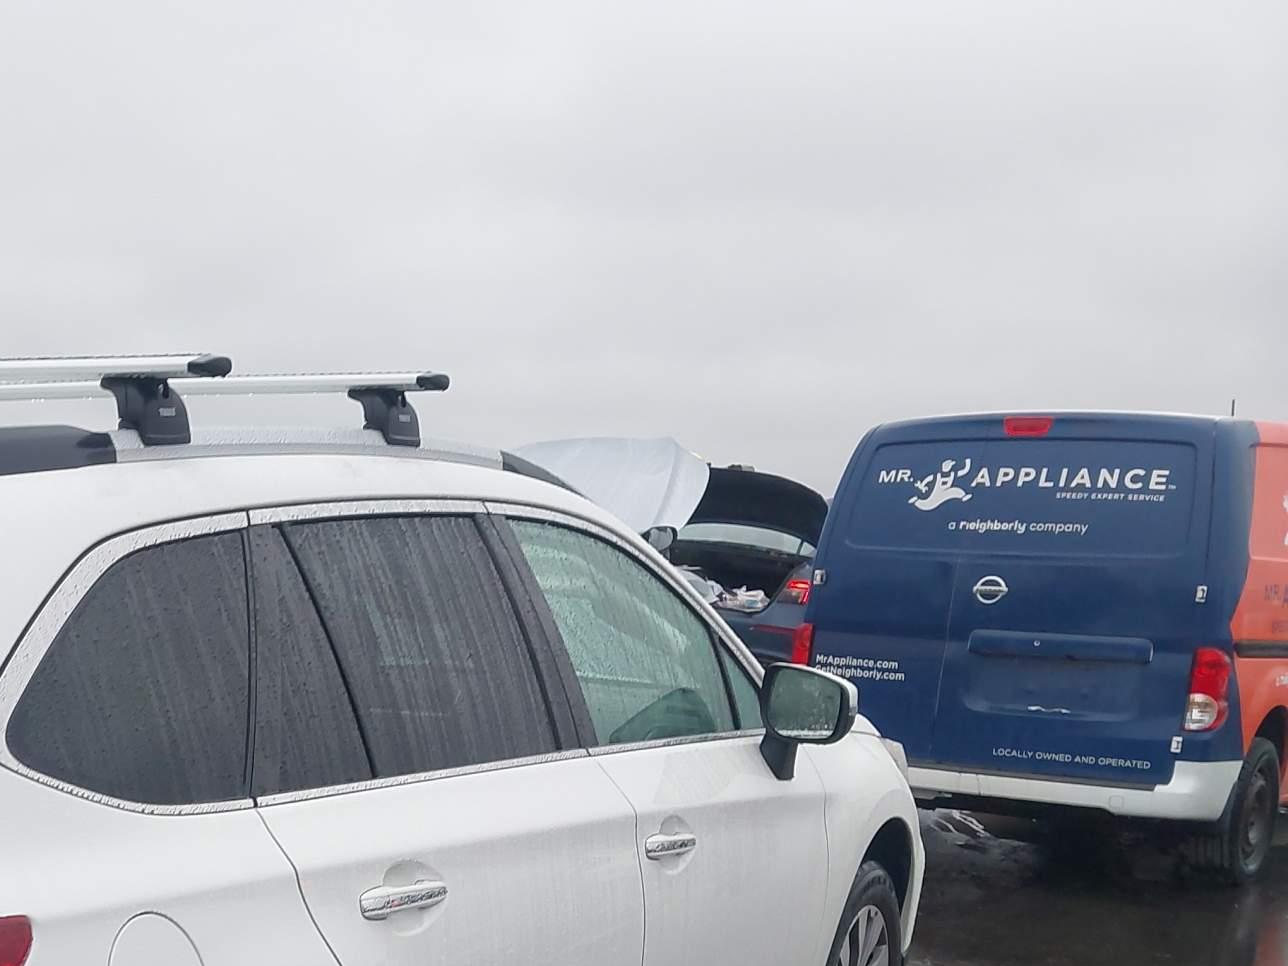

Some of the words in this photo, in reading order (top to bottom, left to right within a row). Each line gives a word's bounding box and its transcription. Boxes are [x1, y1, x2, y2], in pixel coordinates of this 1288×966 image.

[878, 469, 914, 484] MR.
[970, 467, 1170, 490] APPLIANCE
[1055, 492, 1089, 500] SPEEDY
[1091, 493, 1125, 501] EXPERT
[1127, 494, 1165, 502] SERVICE
[948, 521, 956, 530] a
[959, 519, 1027, 534] neighborly
[1029, 522, 1089, 535] company
[815, 653, 899, 670] MrAppliance.com
[992, 747, 1033, 759] LOCALLY
[1035, 751, 1072, 763] OWNED
[1074, 755, 1096, 765] AND
[1097, 757, 1151, 770] OPERATED
